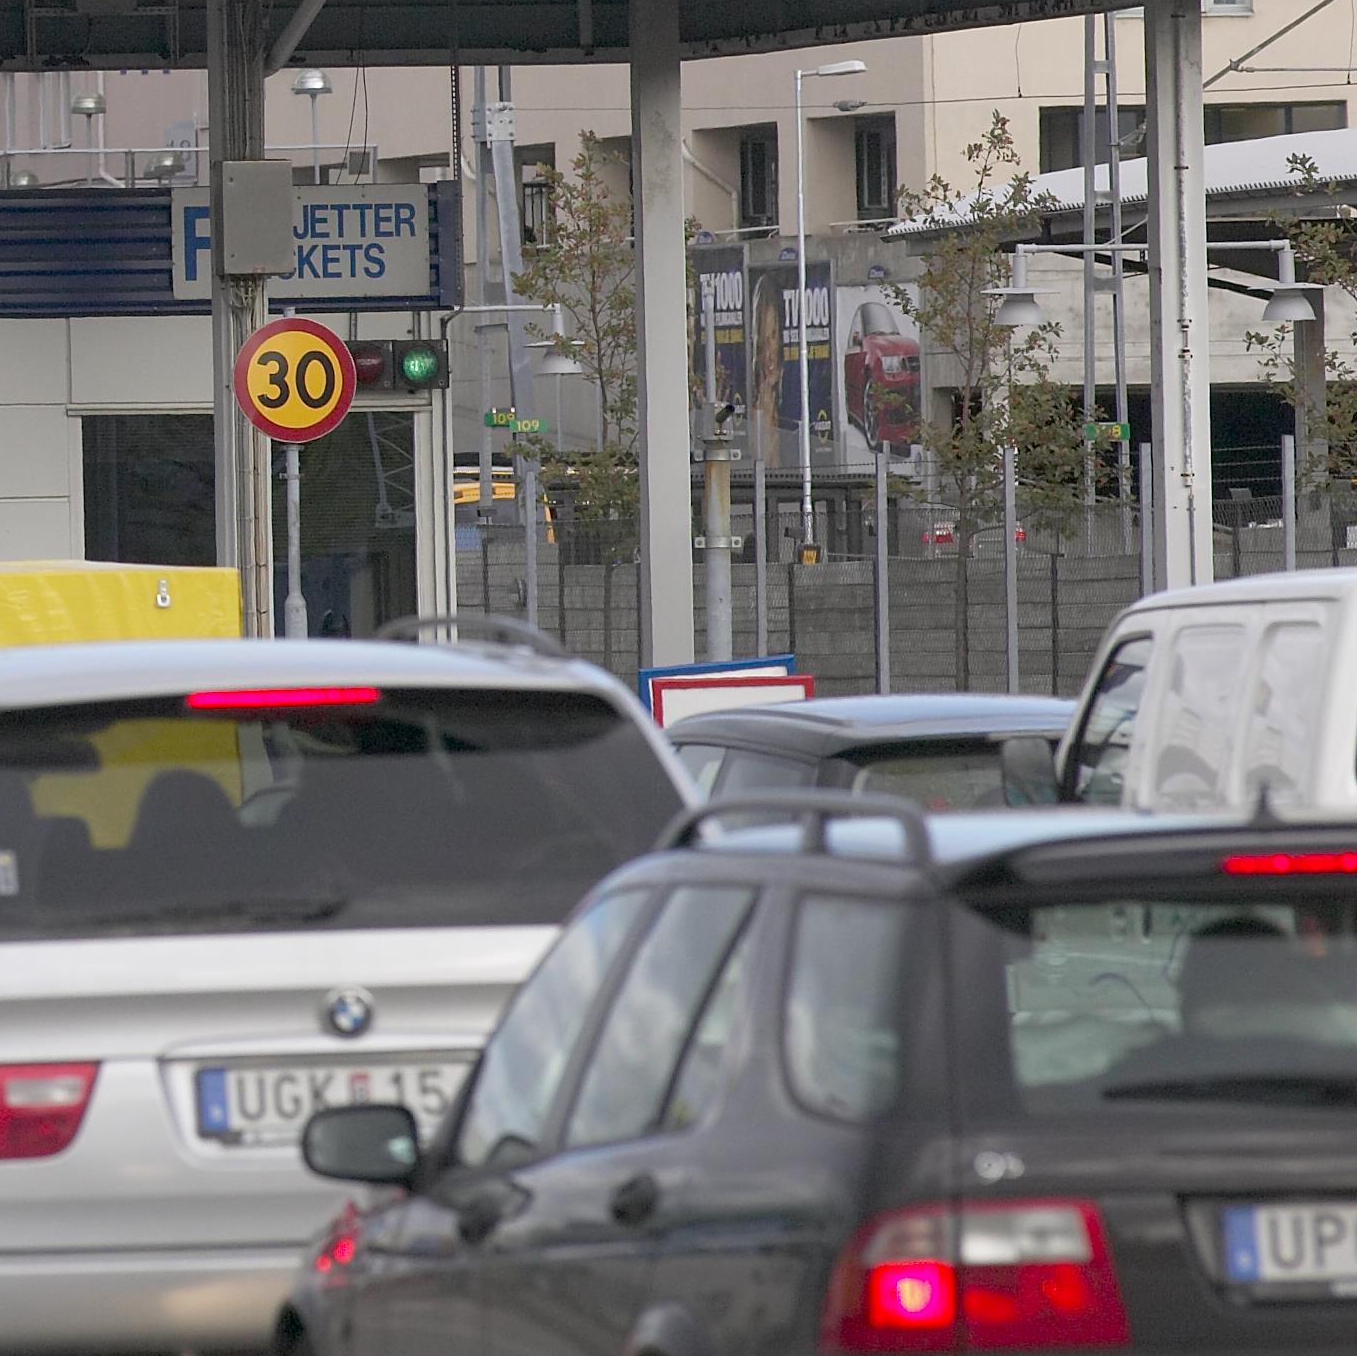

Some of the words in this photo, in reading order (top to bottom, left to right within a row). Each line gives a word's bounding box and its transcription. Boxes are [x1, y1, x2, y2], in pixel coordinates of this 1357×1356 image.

[782, 287, 830, 327] TV000
[256, 350, 336, 410] 30
[1269, 1210, 1357, 1271] UP
